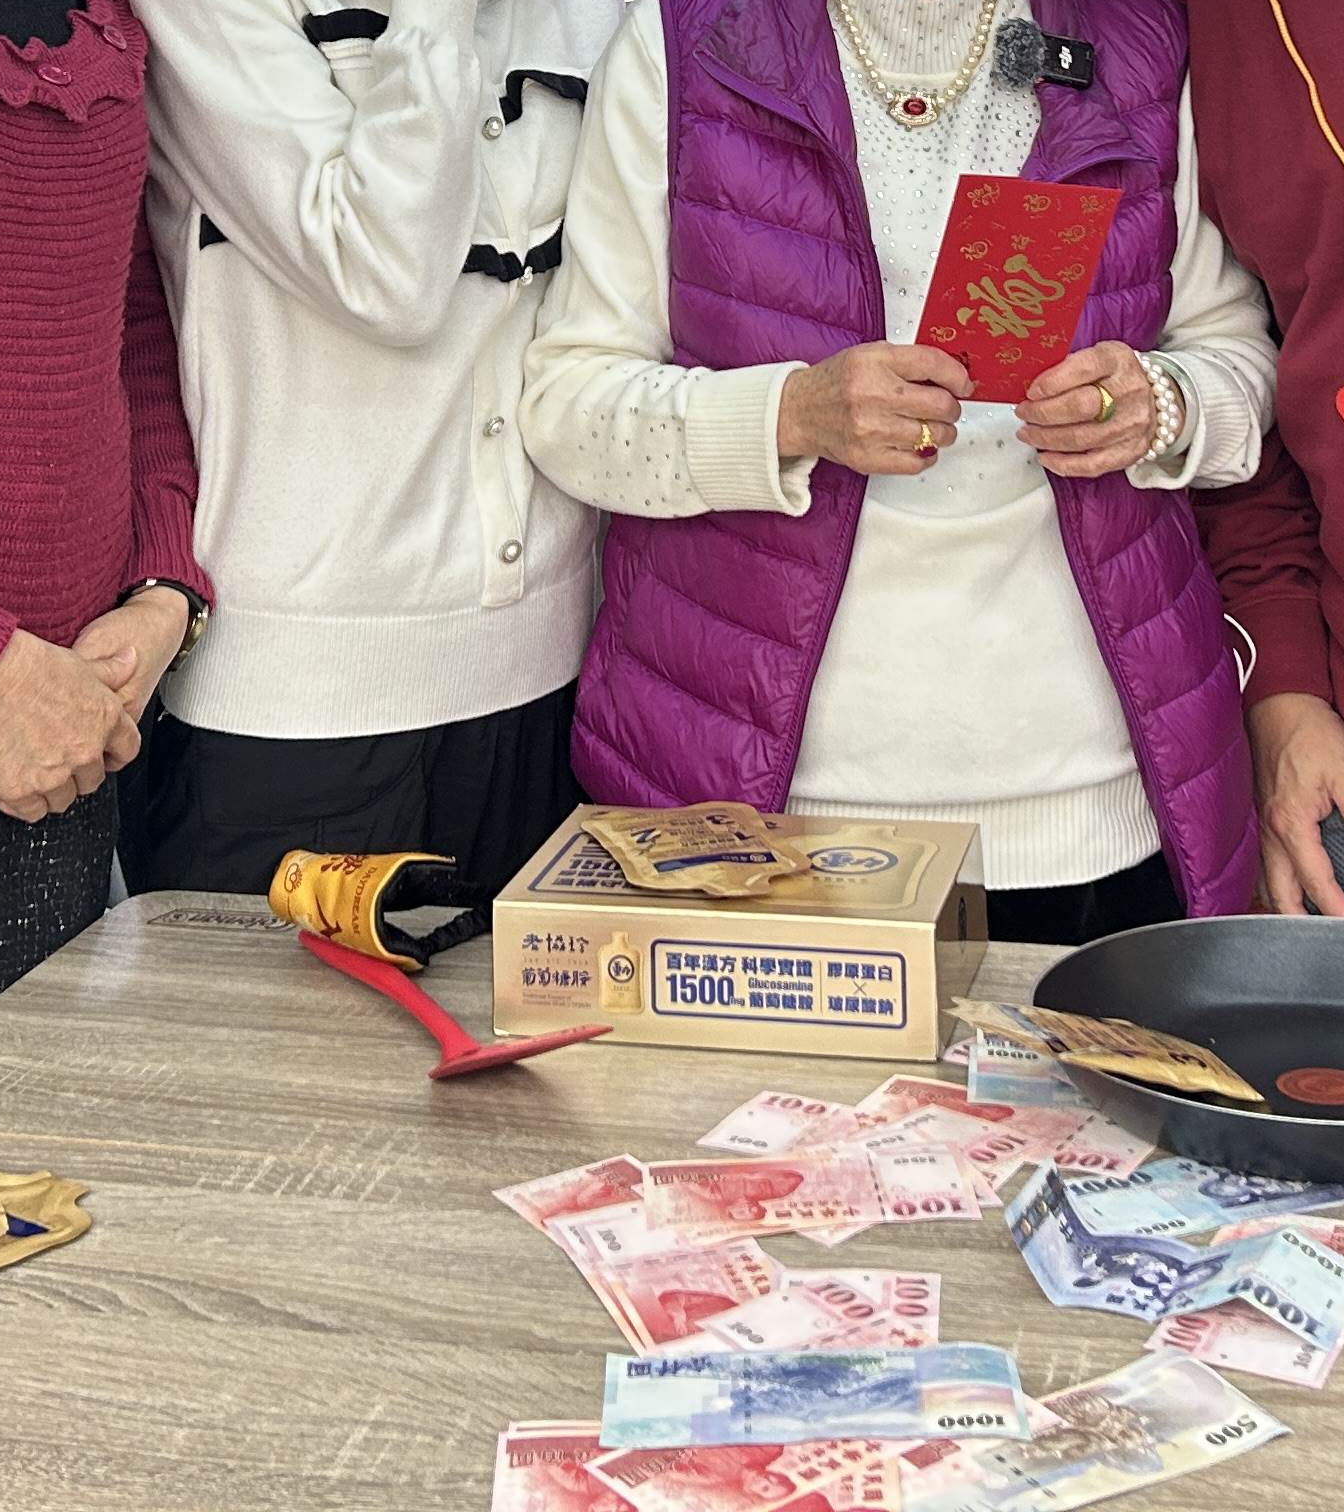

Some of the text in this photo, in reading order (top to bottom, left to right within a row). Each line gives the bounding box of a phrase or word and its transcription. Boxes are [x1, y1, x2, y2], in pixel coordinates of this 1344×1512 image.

[666, 952, 736, 973] 百年漢方
[666, 973, 734, 1006] 1500
[748, 977, 814, 993] Glucosamine
[987, 1048, 1039, 1061] 1000
[767, 1094, 827, 1115] 100
[892, 1197, 963, 1217] 100
[818, 1283, 876, 1319] 100
[892, 1276, 931, 1317] 100
[936, 1413, 1006, 1430] 1000
[1204, 1413, 1258, 1447] 500
